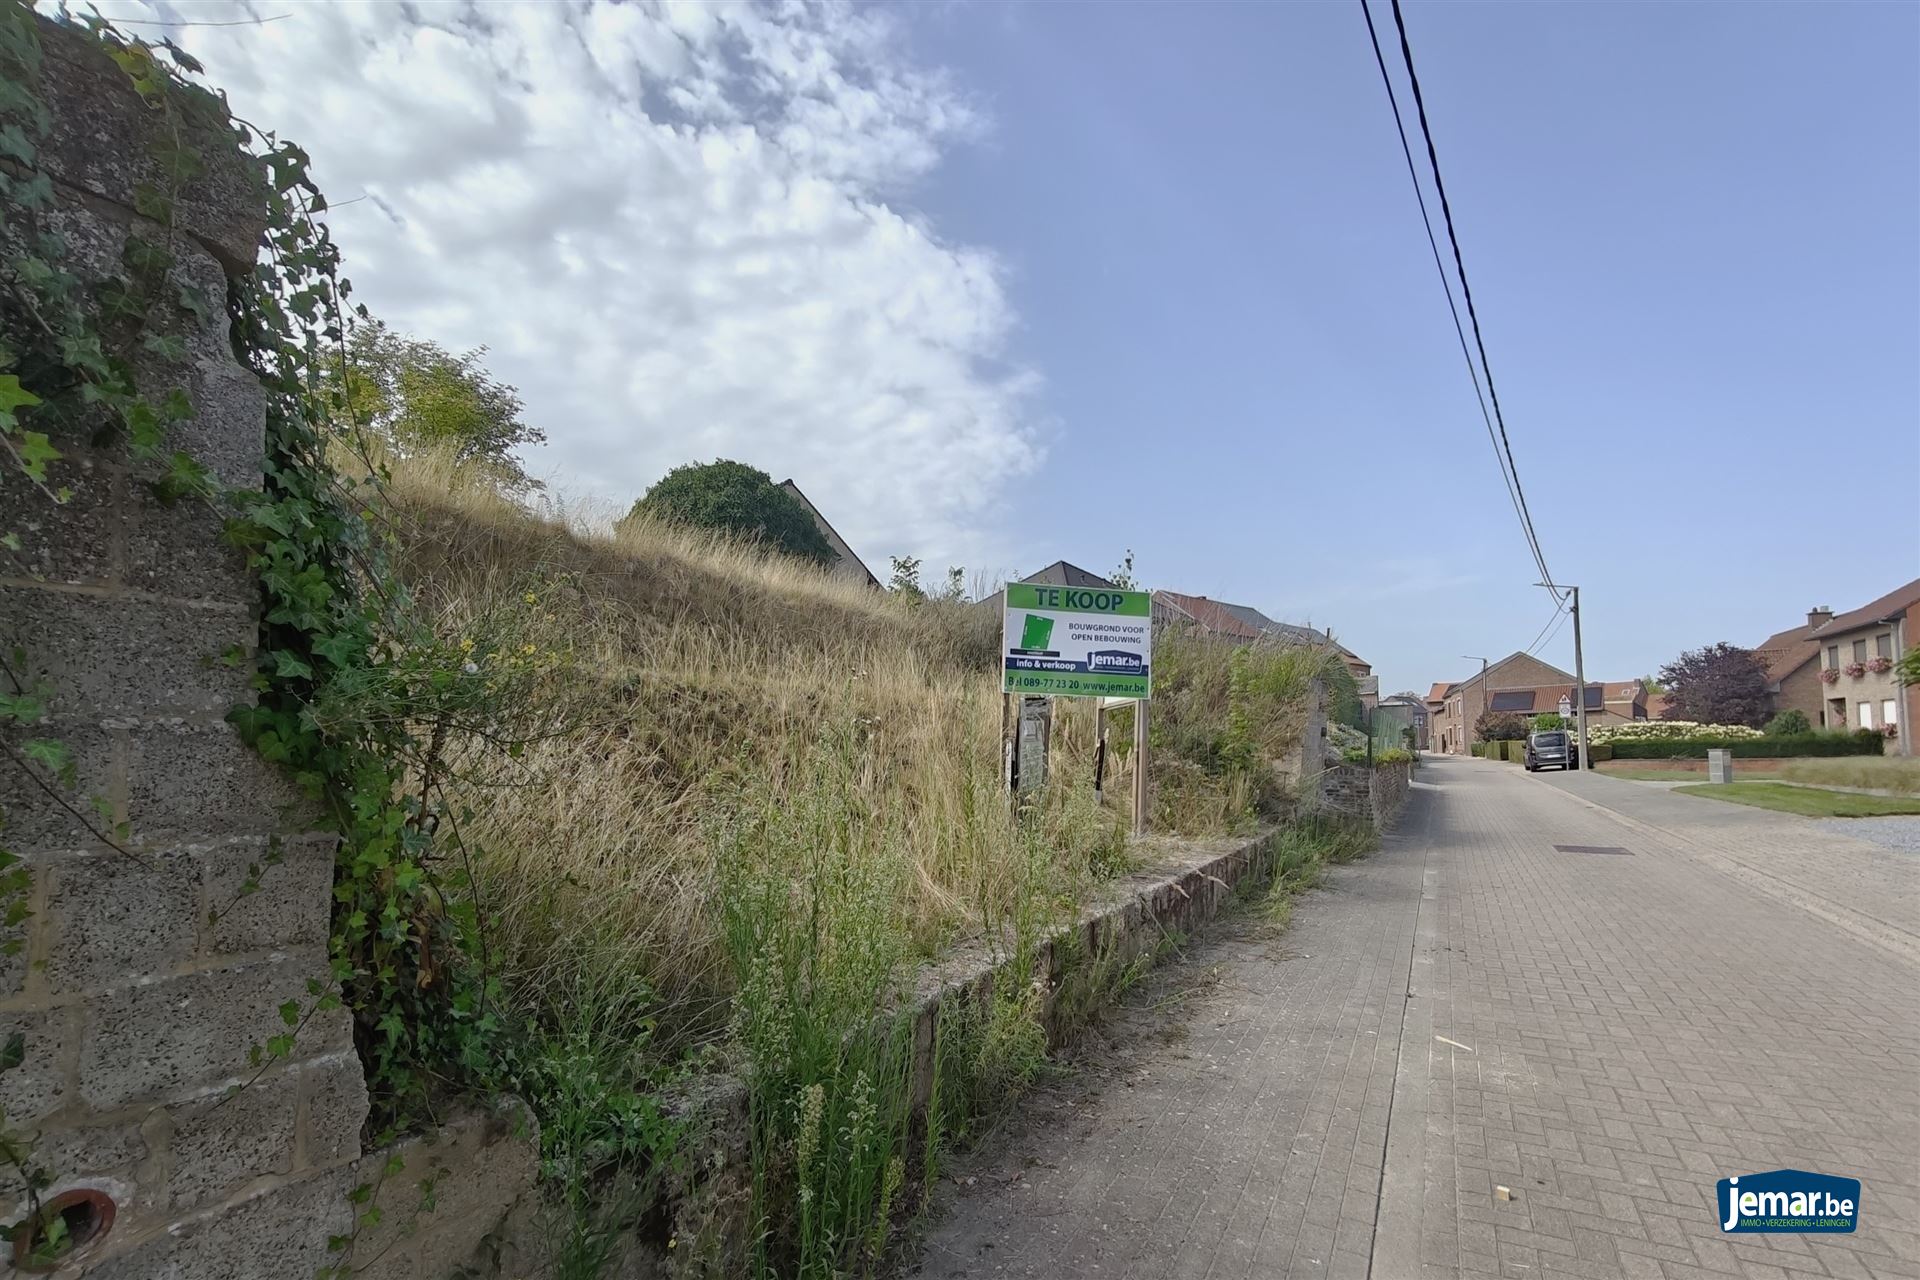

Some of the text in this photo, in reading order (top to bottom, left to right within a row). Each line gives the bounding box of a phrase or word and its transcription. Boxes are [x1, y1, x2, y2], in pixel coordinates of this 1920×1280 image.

[1035, 588, 1124, 611] TE KOOP
[1068, 622, 1144, 634] BOUWGROND VOOR
[1071, 633, 1141, 644] OPEN BEBOUWING
[1016, 659, 1076, 671] info & verkoop
[1088, 651, 1140, 669] jemar.be
[1024, 678, 1053, 688] 089-77
[1056, 680, 1067, 689] 23
[1069, 680, 1080, 689] 20
[1082, 680, 1145, 693] www.jemar.be
